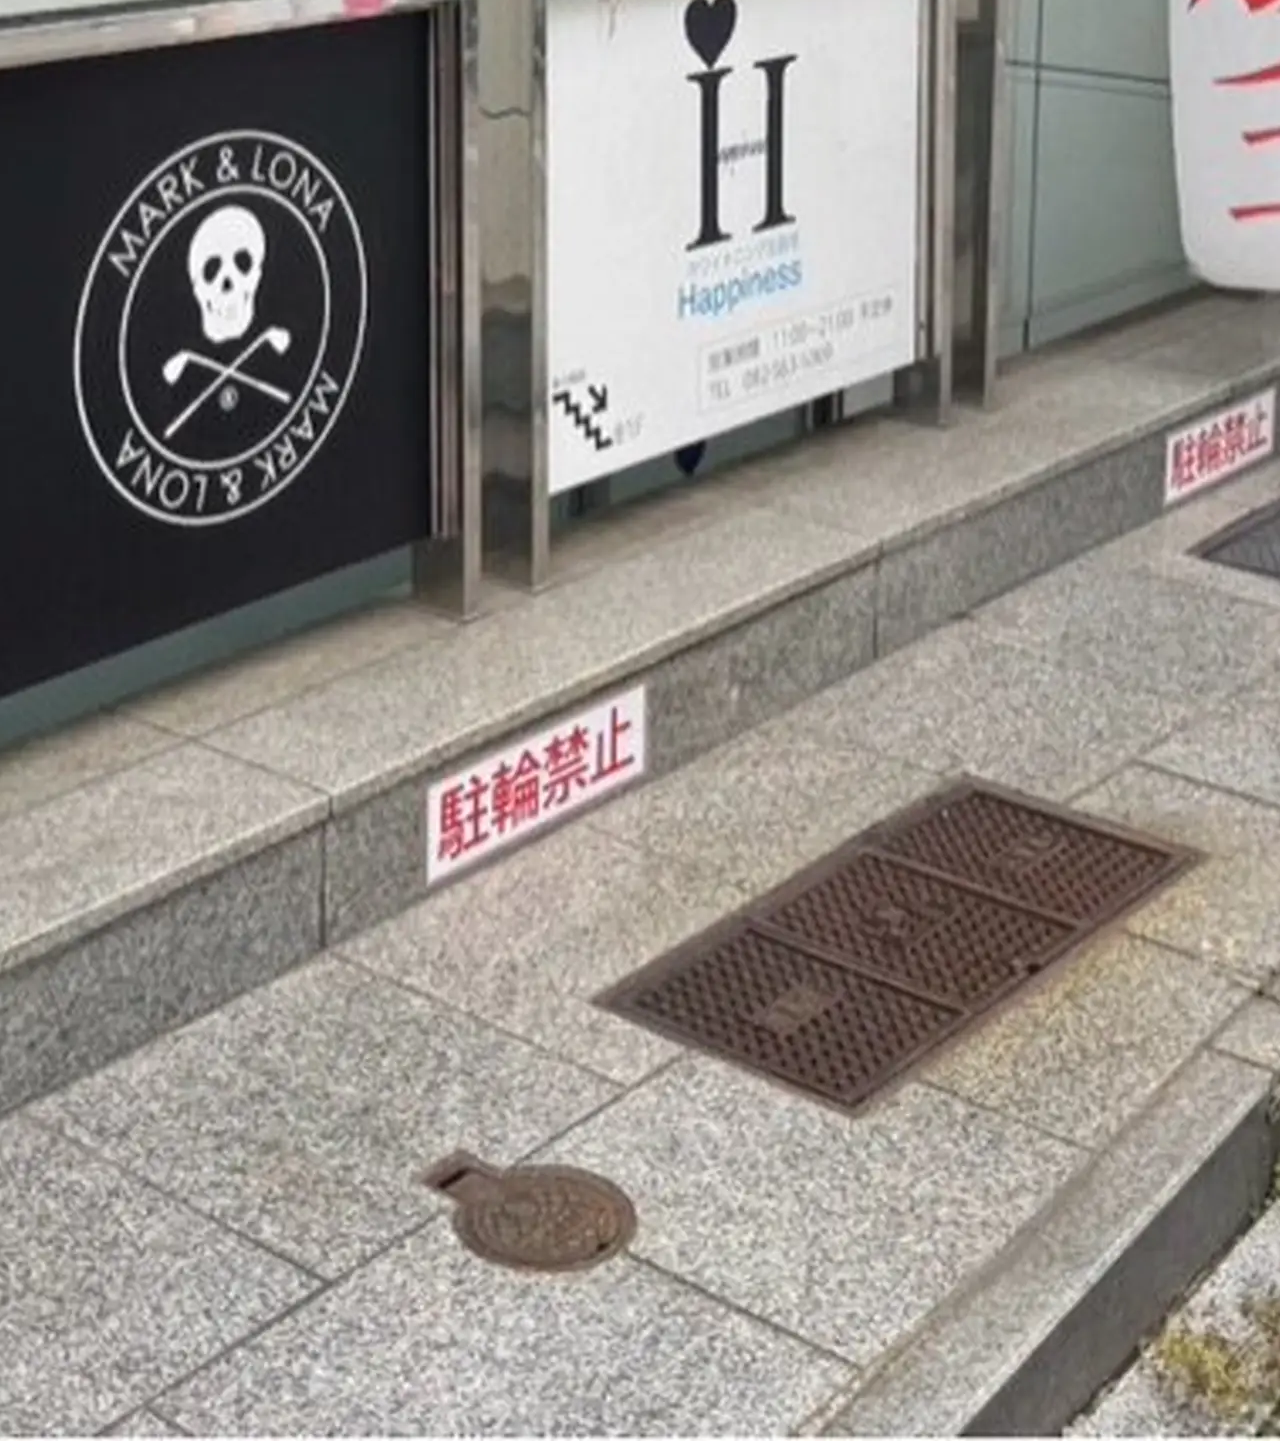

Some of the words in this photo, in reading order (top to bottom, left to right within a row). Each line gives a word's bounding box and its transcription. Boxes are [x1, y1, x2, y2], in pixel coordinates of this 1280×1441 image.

[109, 156, 204, 278] MARK
[216, 146, 239, 183] &
[250, 144, 334, 232] LONA
[677, 258, 803, 321] Happiness
[117, 428, 207, 512] LONA
[254, 370, 340, 492] MARK
[221, 469, 242, 505] &
[436, 707, 634, 861] 駐輪禁止
